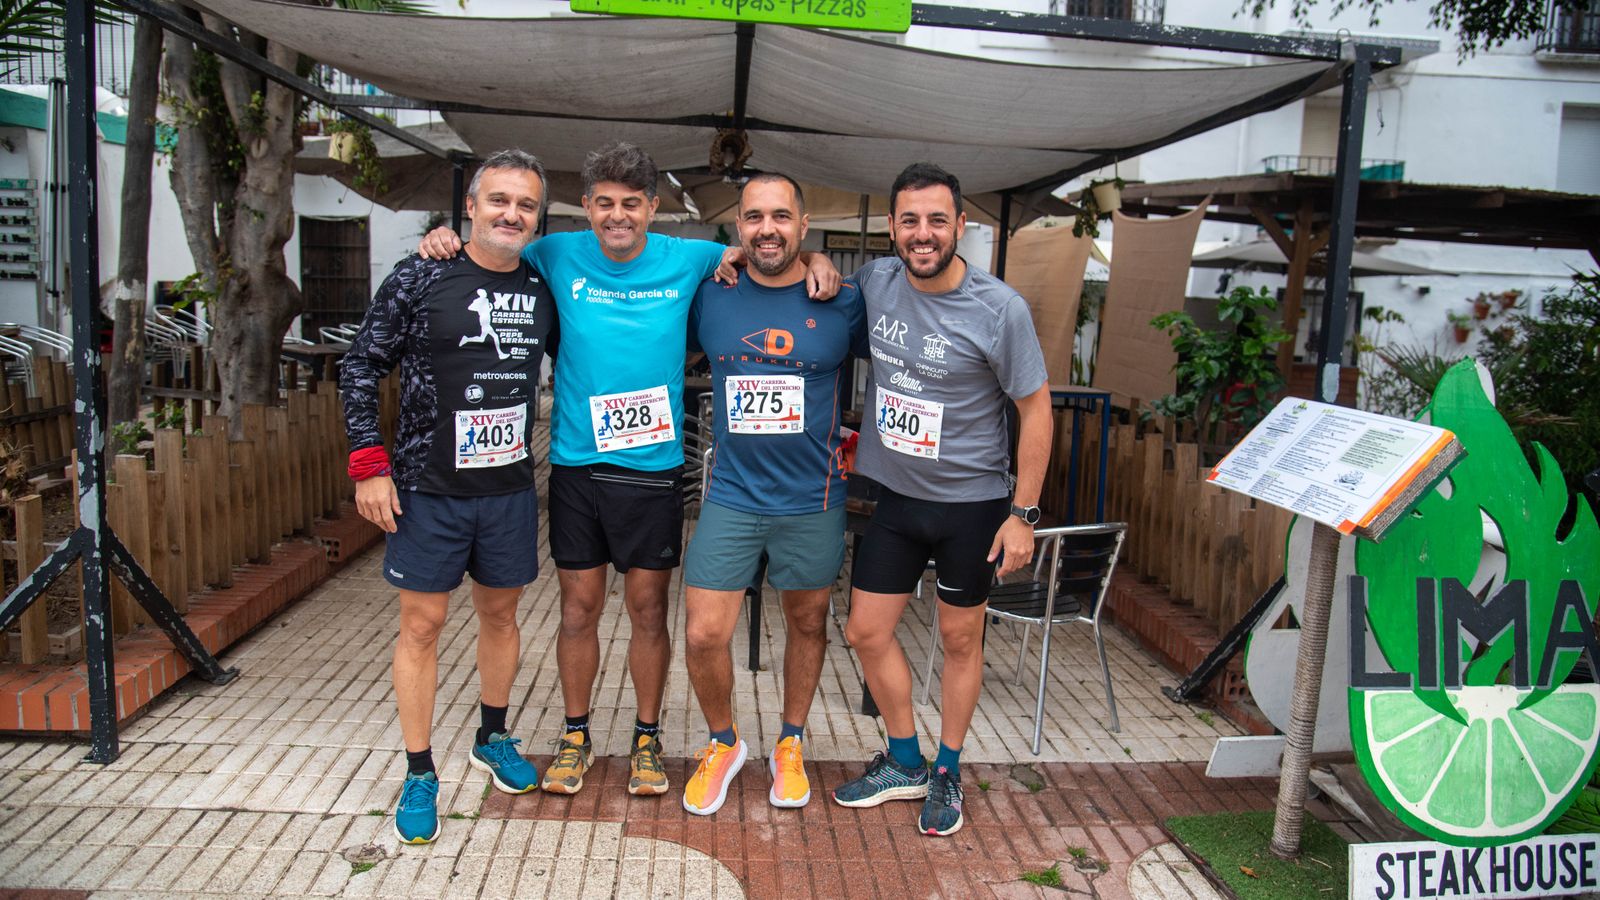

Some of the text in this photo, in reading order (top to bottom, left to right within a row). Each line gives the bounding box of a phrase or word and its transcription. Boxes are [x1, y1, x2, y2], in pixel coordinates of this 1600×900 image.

[586, 287, 626, 299] Yolanda
[664, 289, 679, 298] Gil
[493, 292, 537, 312] XIV
[491, 311, 531, 319] CARRERA
[491, 317, 534, 325] ESTRECHO
[510, 346, 518, 355] 8
[718, 355, 818, 370] HIRUKIDE
[473, 371, 527, 380] metrovacesa
[736, 380, 761, 391] XIV
[603, 397, 628, 411] XIV
[628, 393, 653, 402] CARRERA
[640, 396, 667, 406] ESTRECHO
[743, 391, 784, 414] 275
[884, 393, 926, 410] XIV CARRERA
[469, 414, 496, 427] XIV
[495, 411, 517, 419] CARRERA
[612, 405, 652, 431] 328
[886, 407, 920, 437] 340
[476, 423, 514, 448] 403
[1347, 574, 1600, 692] LIMA
[1375, 841, 1597, 900] STEAKHOUSE
